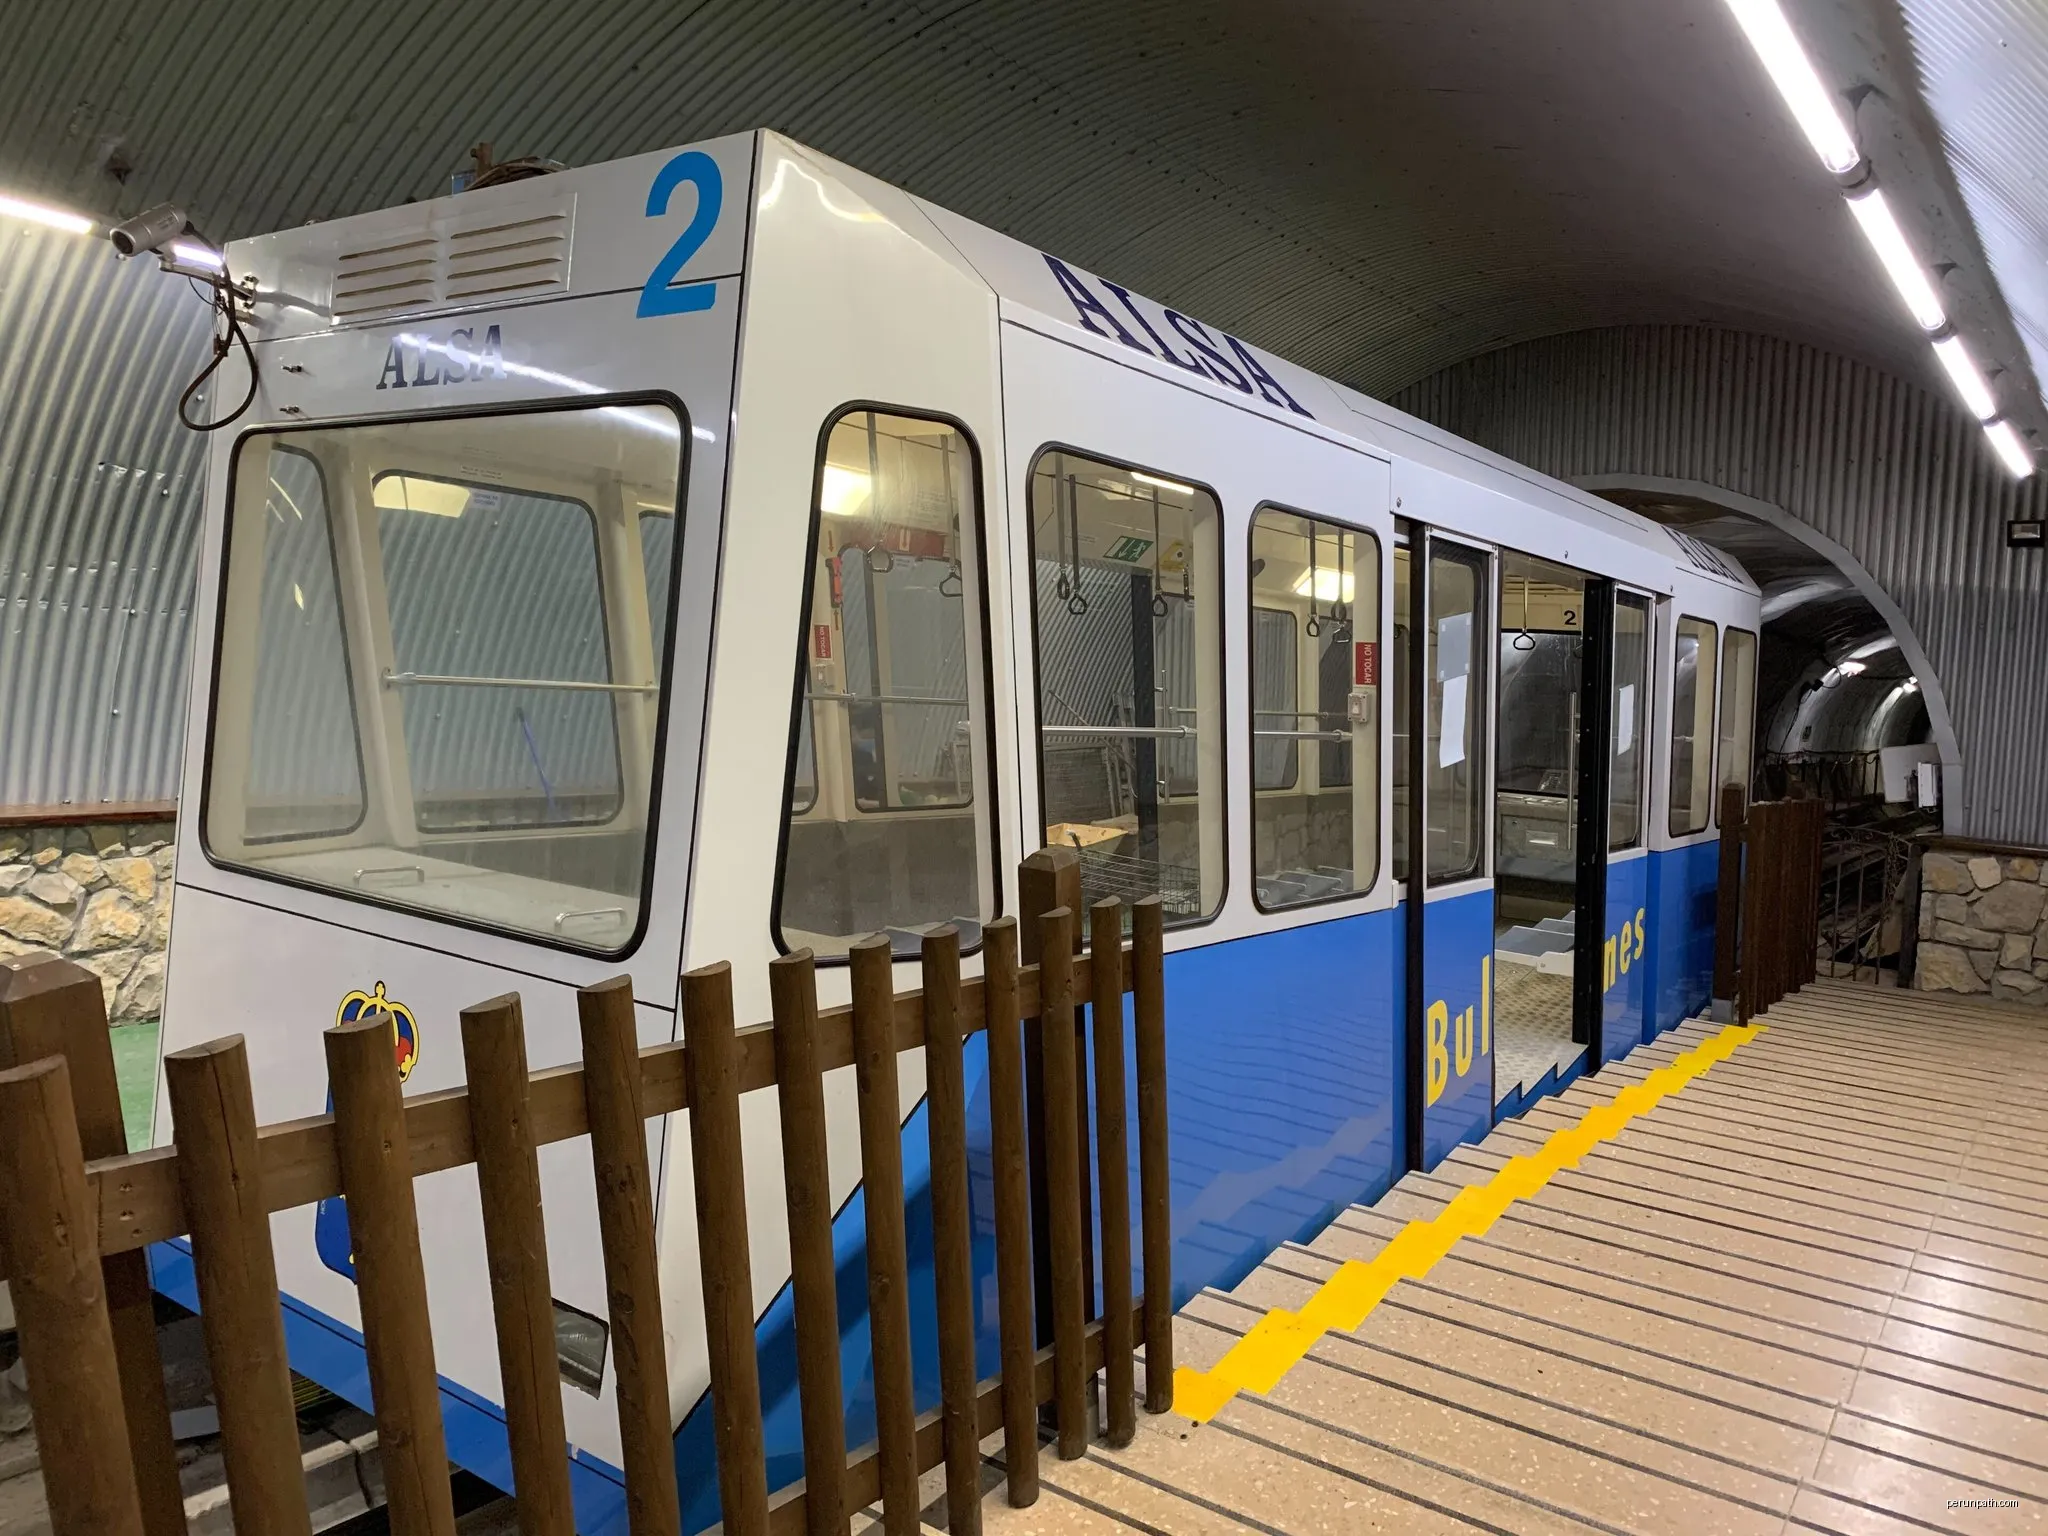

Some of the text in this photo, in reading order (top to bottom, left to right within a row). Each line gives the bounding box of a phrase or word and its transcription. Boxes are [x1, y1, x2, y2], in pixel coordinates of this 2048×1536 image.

[636, 151, 723, 319] 2
[376, 325, 507, 389] ALSA
[1041, 252, 1316, 420] ALSA
[1364, 644, 1372, 684] NO TOCAR
[1564, 609, 1577, 626] 2
[1426, 954, 1491, 1108] Bul
